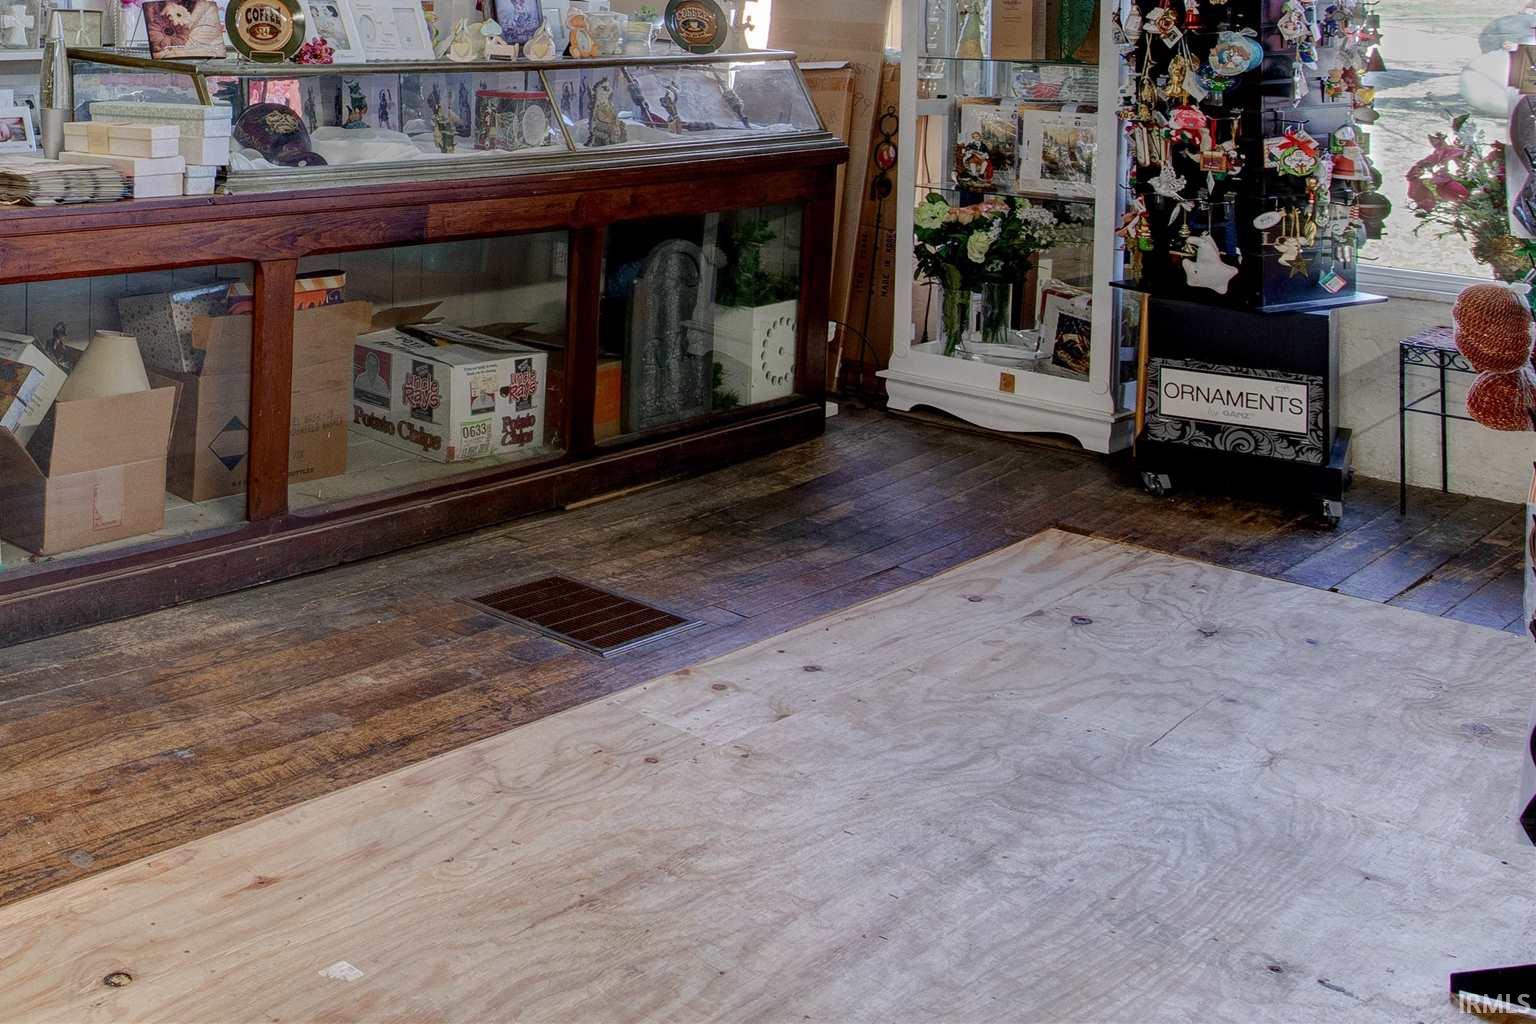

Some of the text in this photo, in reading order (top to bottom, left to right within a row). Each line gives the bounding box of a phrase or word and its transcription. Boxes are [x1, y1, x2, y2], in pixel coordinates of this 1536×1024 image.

[1164, 382, 1304, 415] ORNAMENTS
[353, 404, 396, 436] Potato
[398, 420, 443, 452] Chips
[462, 422, 488, 439] 0633
